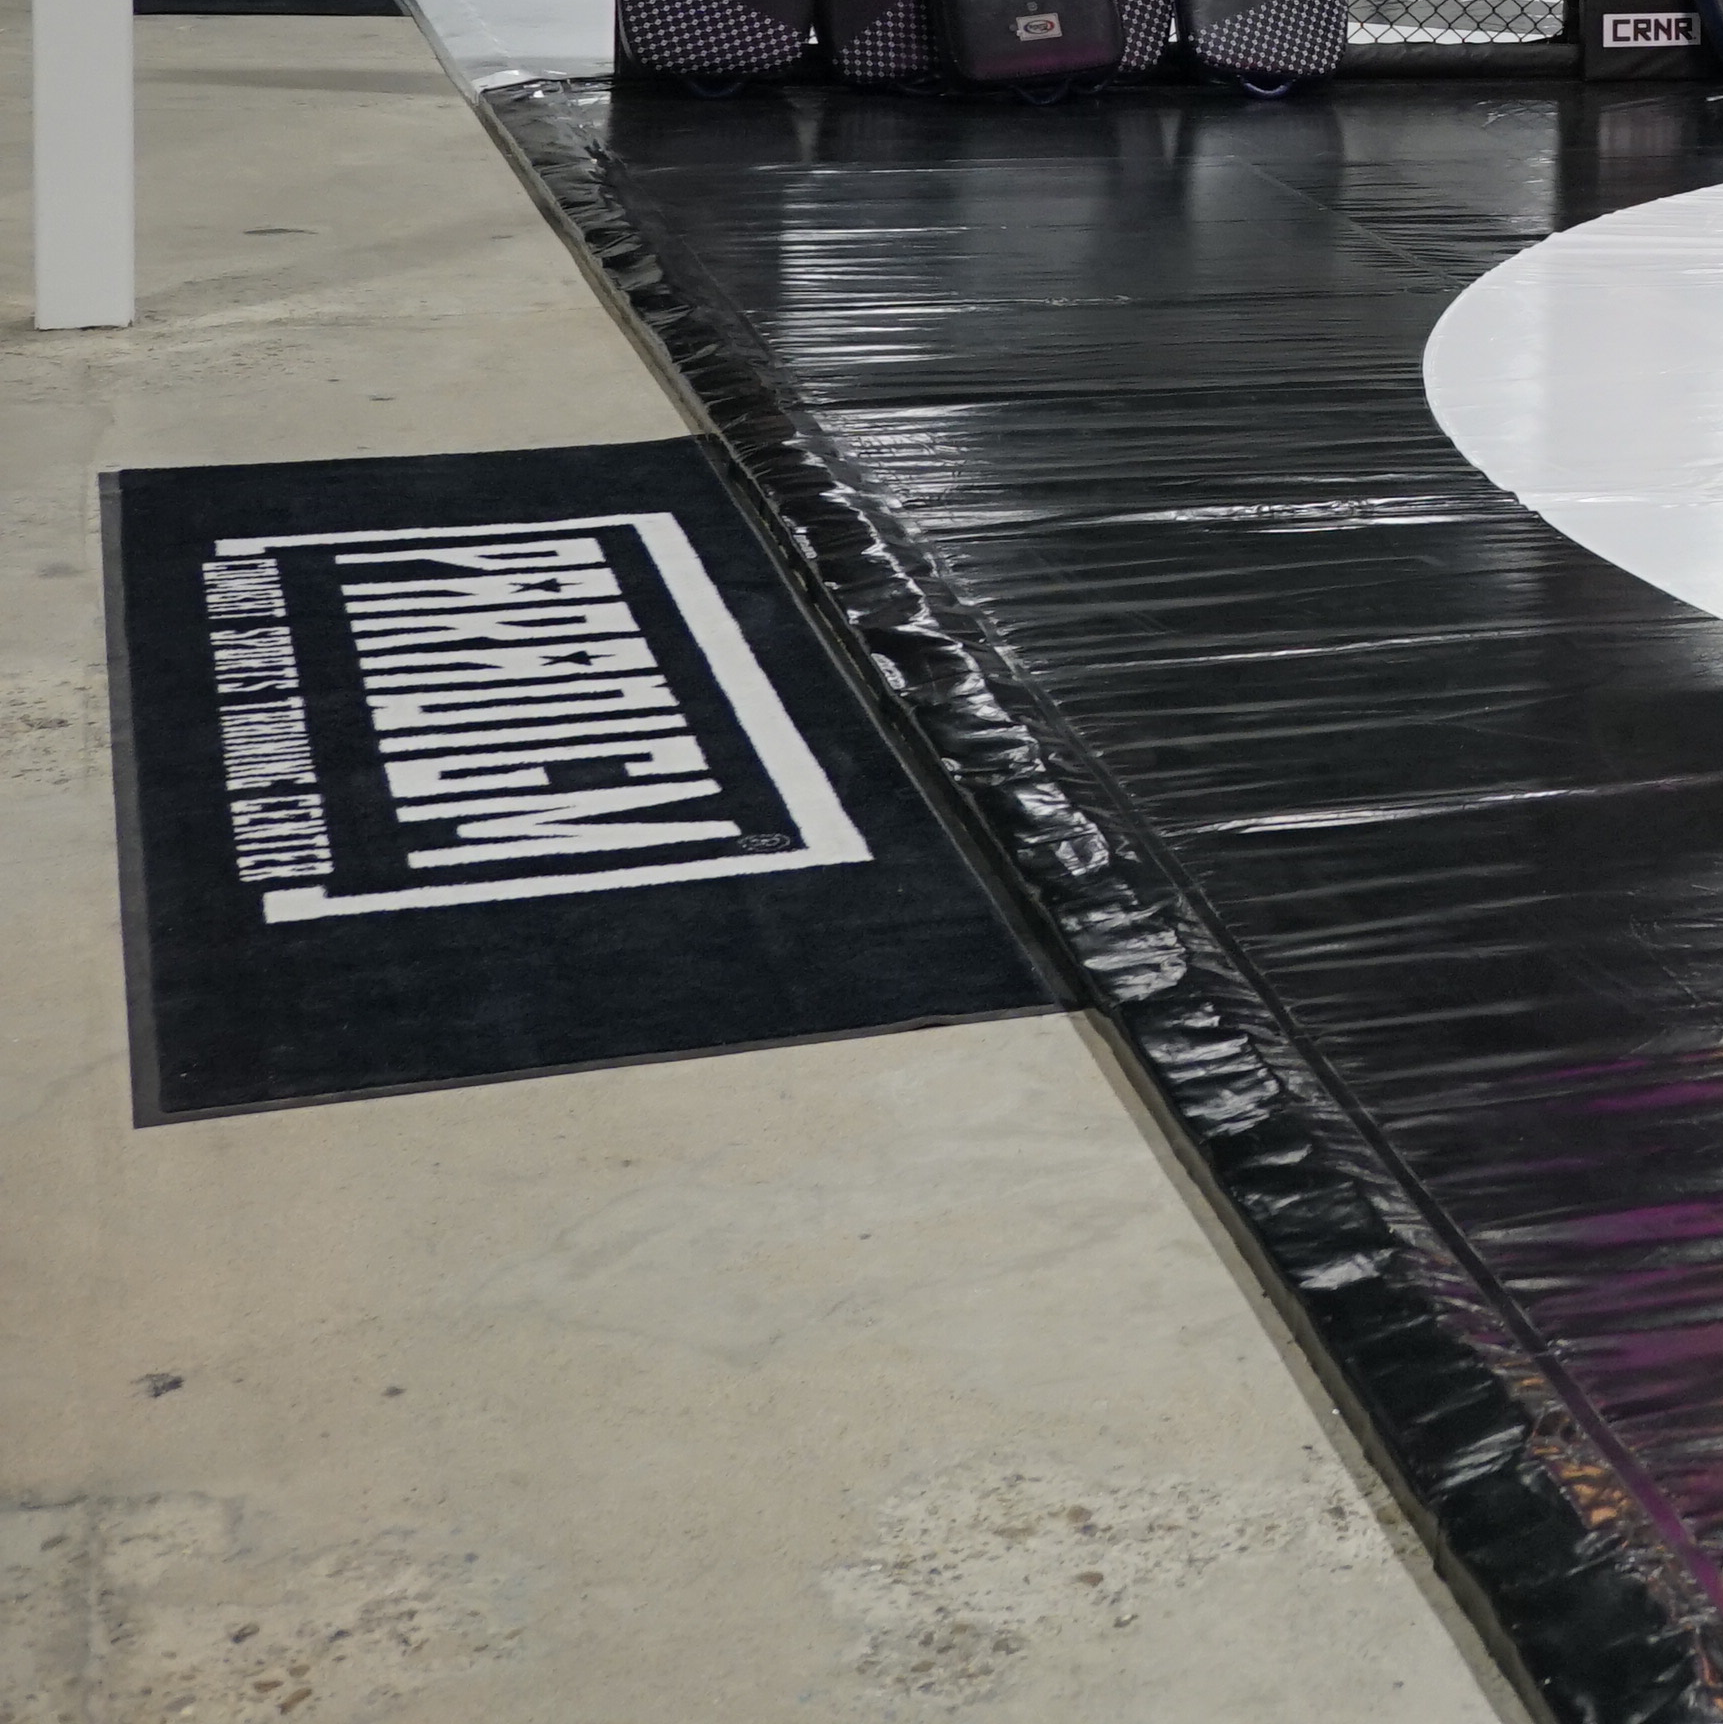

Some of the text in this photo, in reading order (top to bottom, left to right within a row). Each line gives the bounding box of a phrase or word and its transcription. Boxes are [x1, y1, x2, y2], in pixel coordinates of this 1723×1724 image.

[1612, 18, 1693, 42] CRNR
[202, 558, 336, 883] COMBAT SPORTS TRAINING CENTER
[335, 537, 742, 870] PARADIGM
